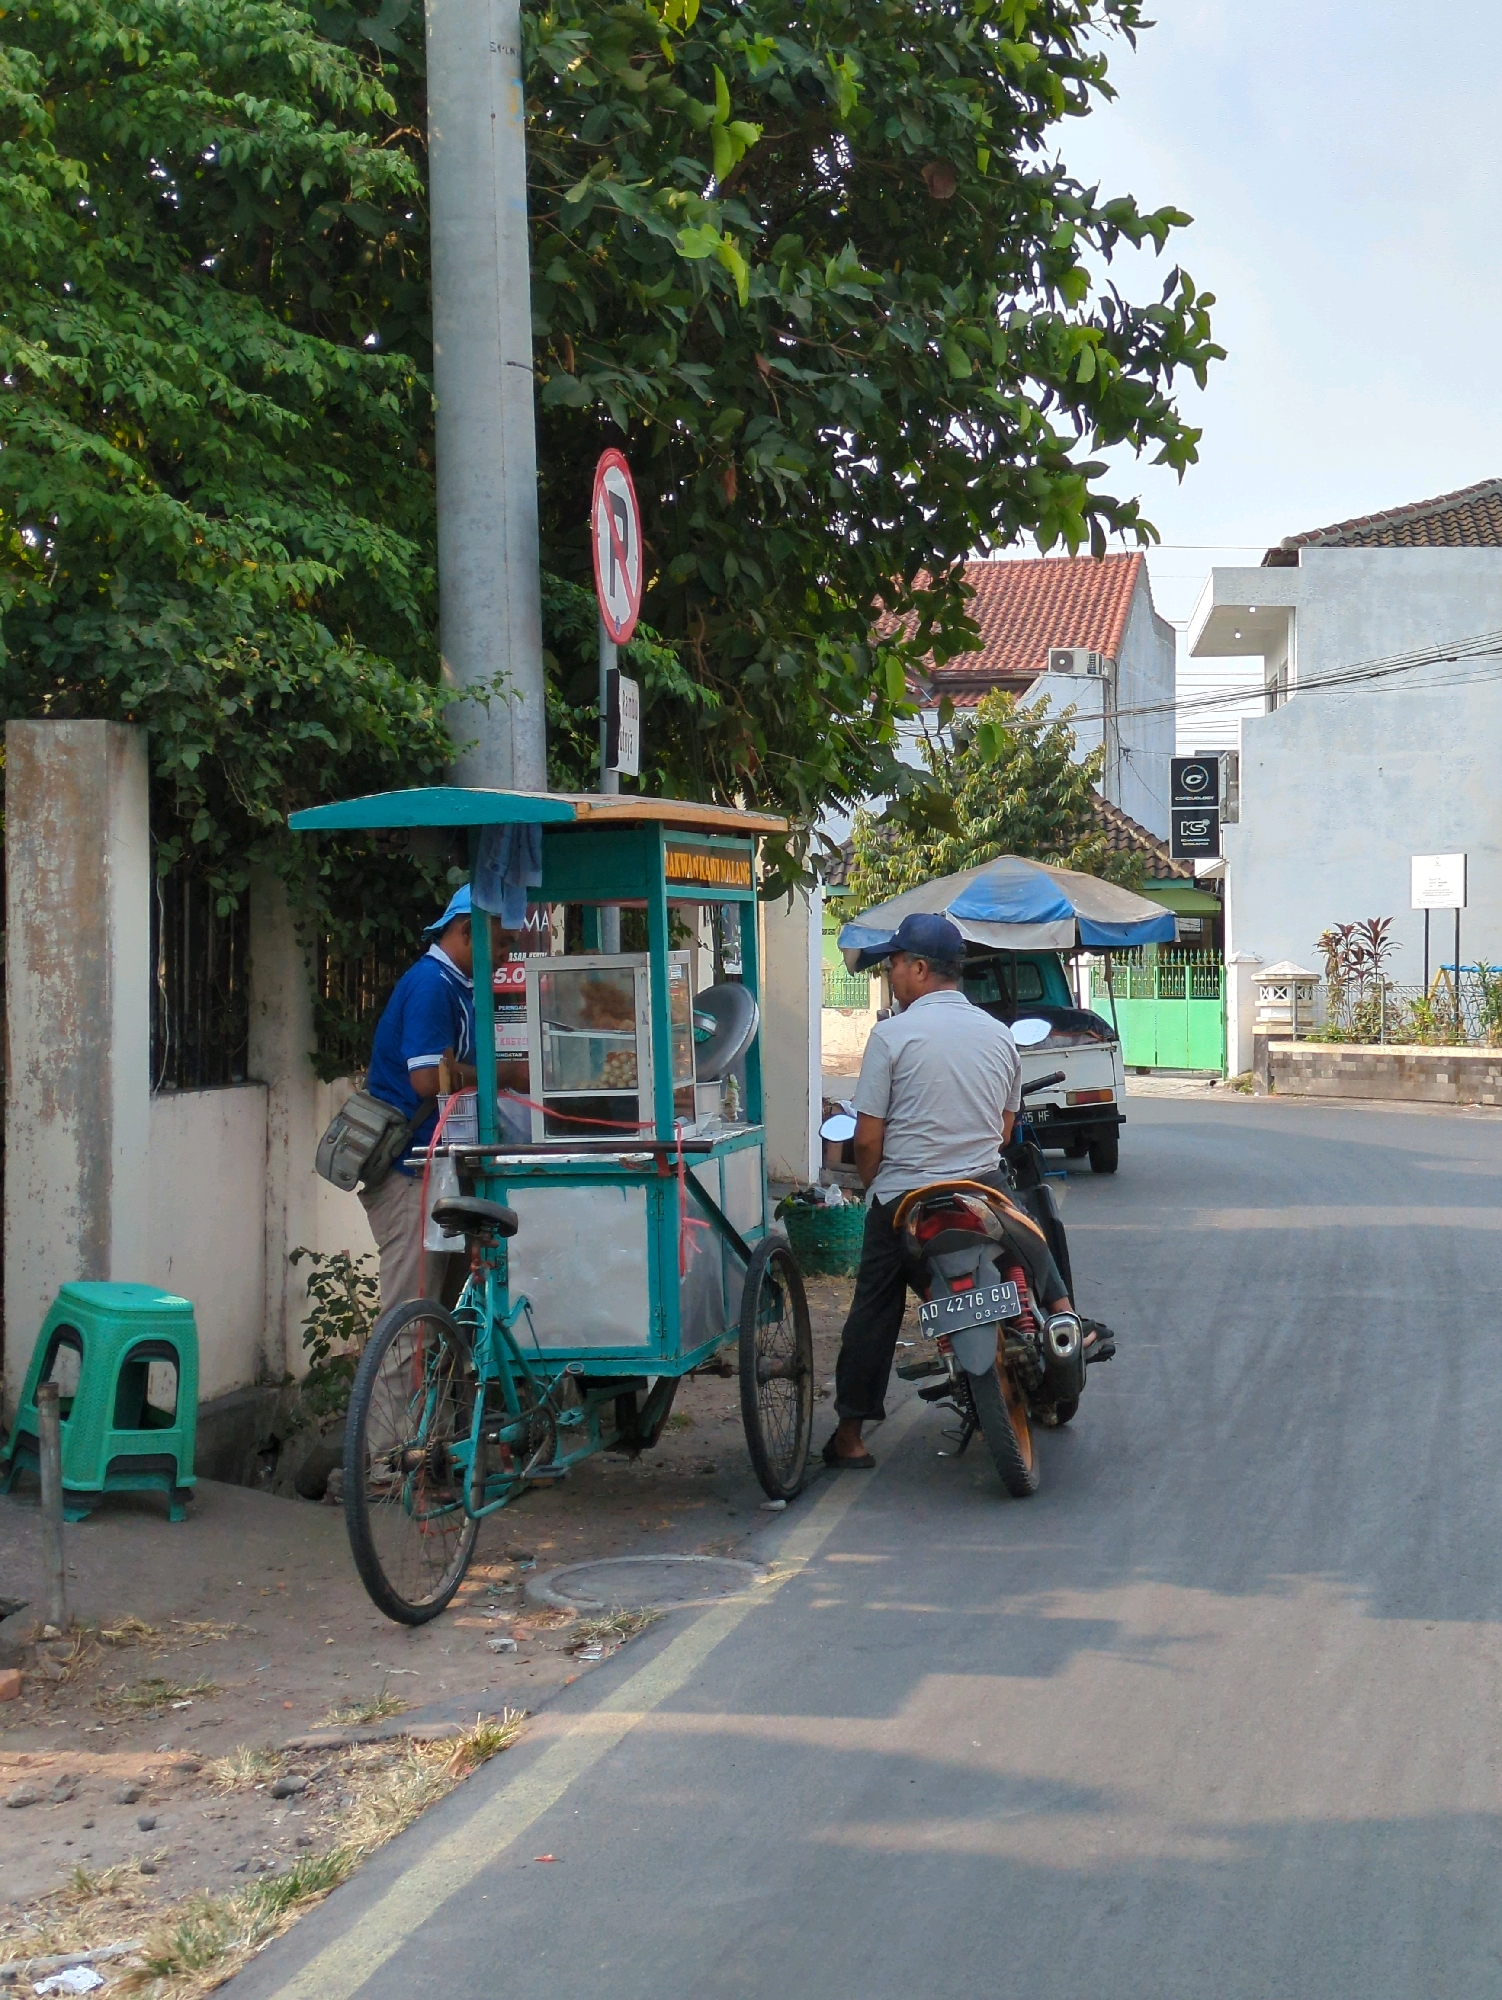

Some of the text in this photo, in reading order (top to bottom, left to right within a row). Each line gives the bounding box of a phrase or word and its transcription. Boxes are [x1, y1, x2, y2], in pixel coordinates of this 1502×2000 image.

[720, 859, 750, 885] MALANG
[921, 1285, 1011, 1322] AD 4276 GU
